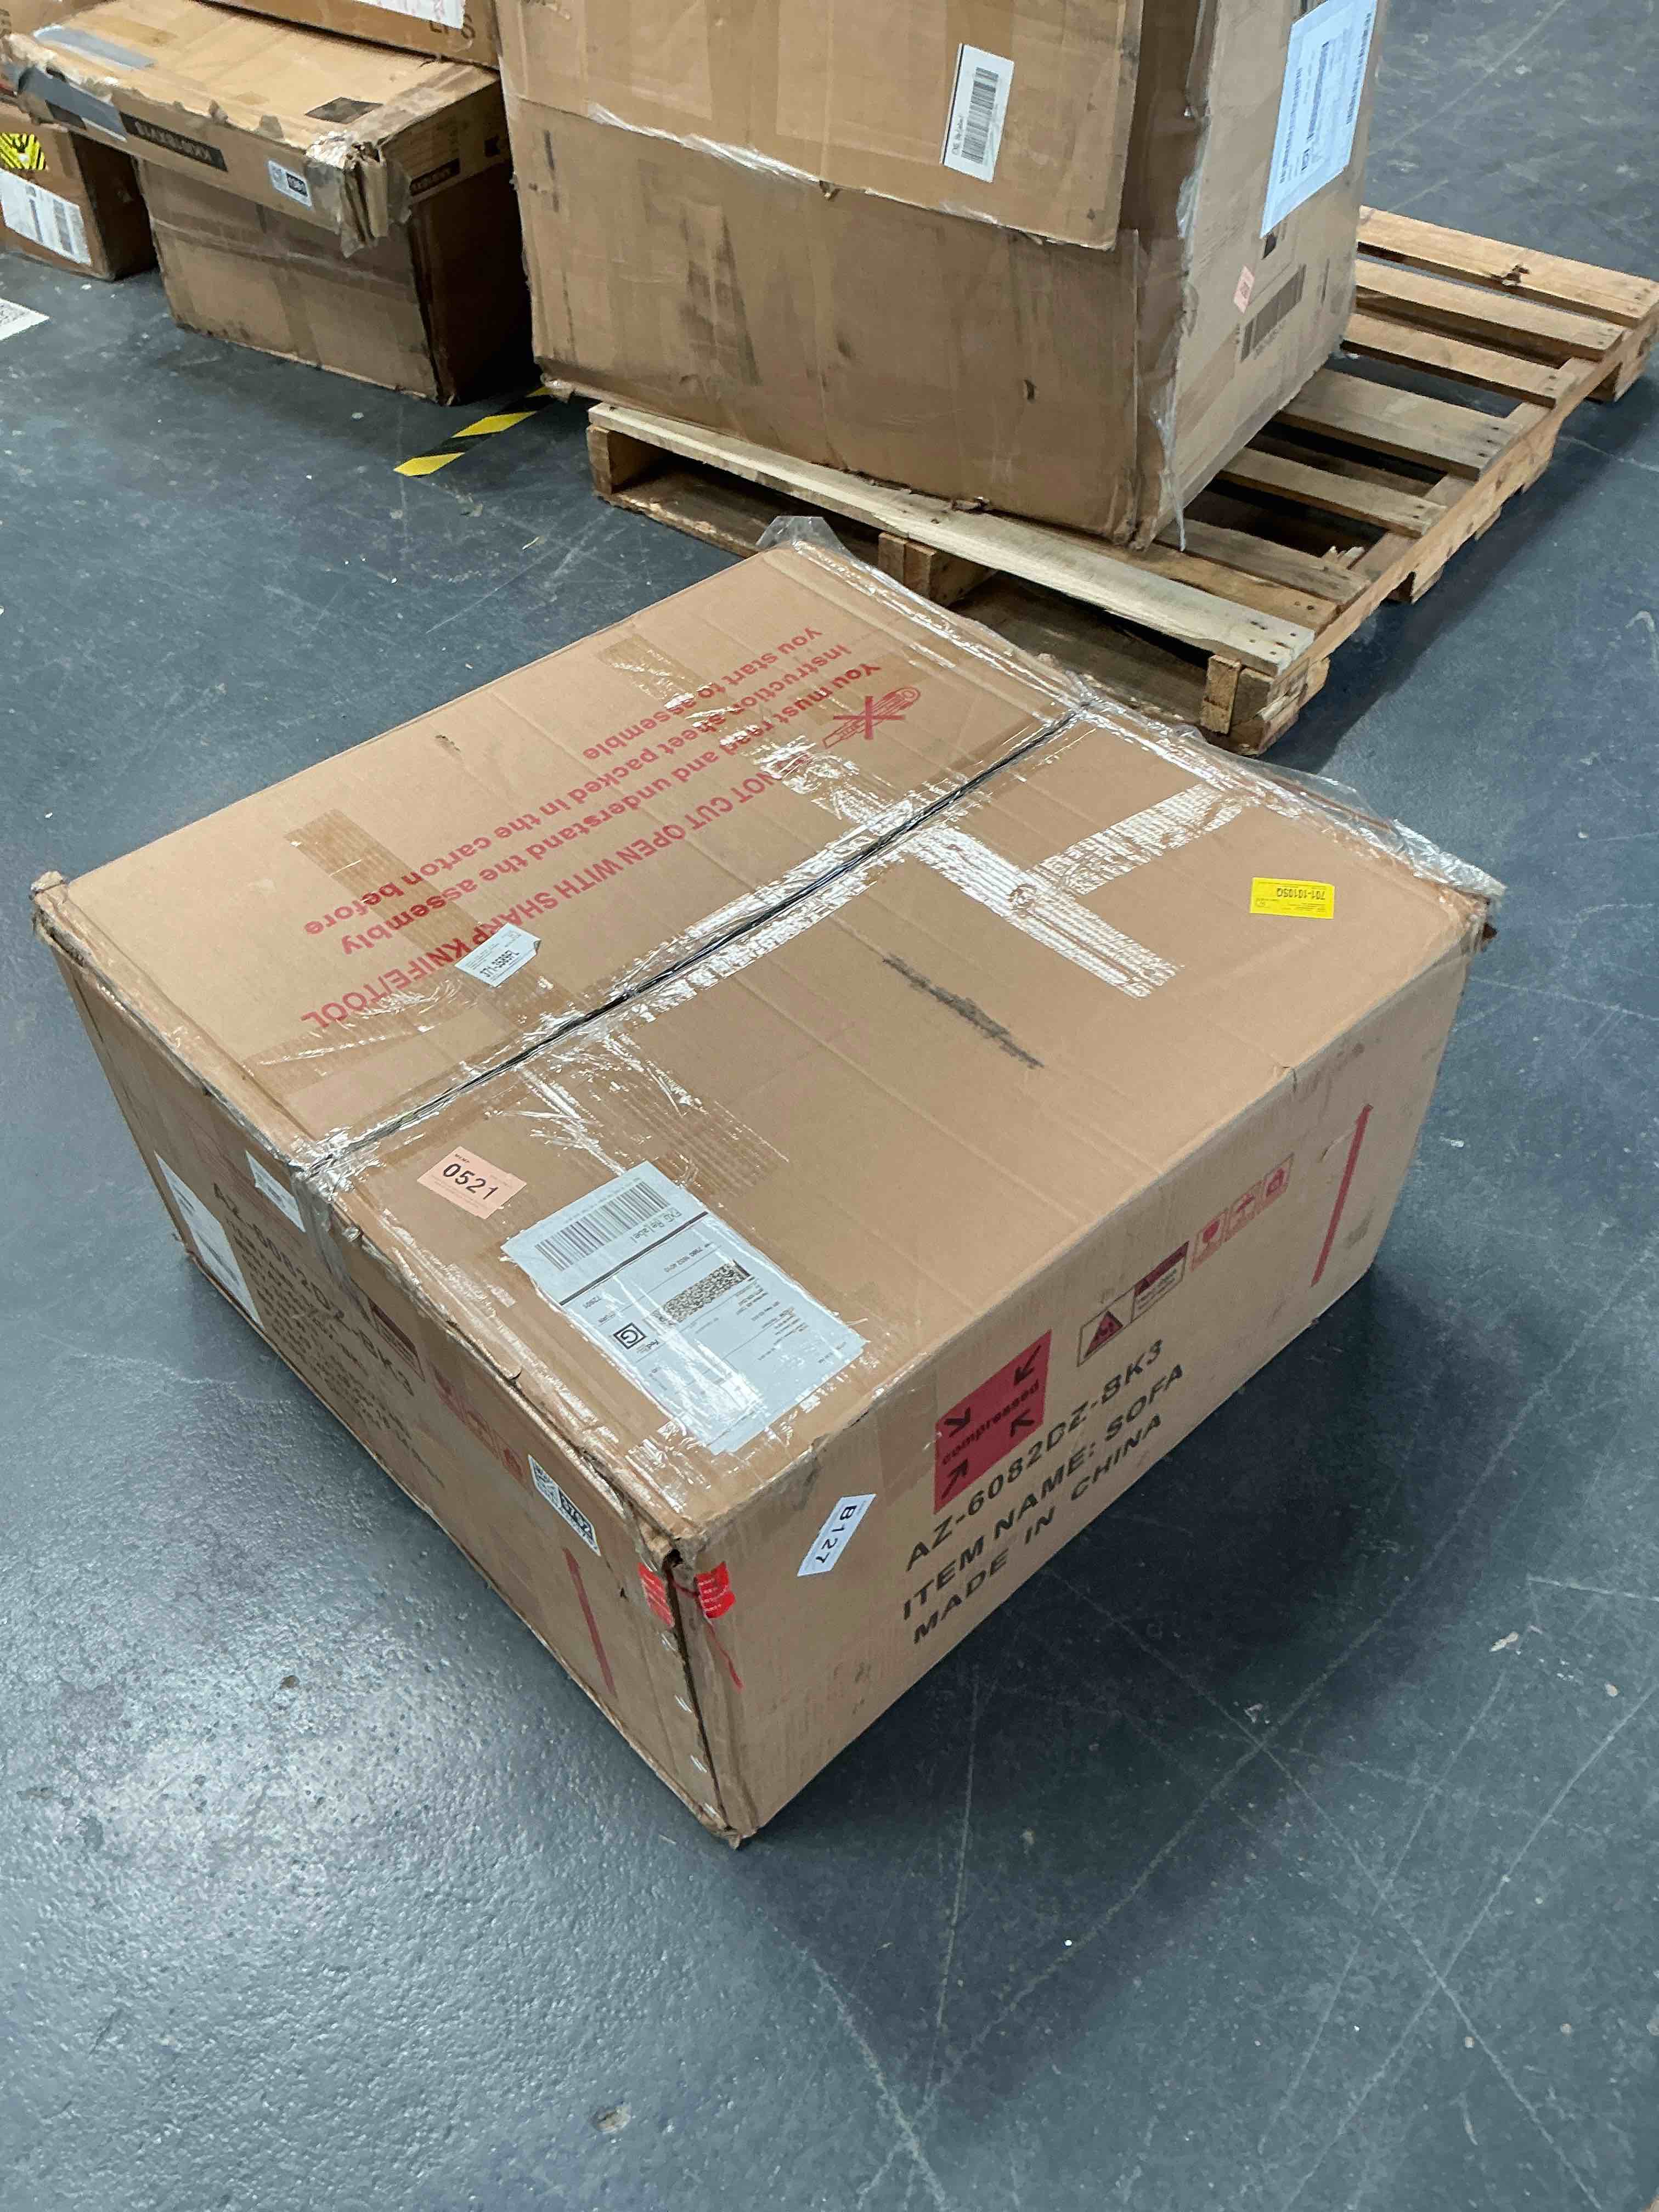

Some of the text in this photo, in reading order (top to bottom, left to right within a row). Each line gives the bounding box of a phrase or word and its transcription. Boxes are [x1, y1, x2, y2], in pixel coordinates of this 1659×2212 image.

[777, 627, 823, 656] you
[697, 681, 726, 698] to
[722, 652, 778, 687] start
[831, 663, 882, 690] You
[772, 687, 831, 726] must
[567, 747, 659, 804] packed
[671, 750, 720, 783] and
[494, 813, 541, 839] the
[526, 777, 673, 861] understand
[539, 798, 572, 817] in
[684, 796, 735, 831] CUT
[400, 837, 492, 885] carton
[615, 823, 687, 866] OPEN
[478, 854, 529, 881] the
[552, 858, 624, 900] WITH
[304, 882, 405, 935] before
[341, 878, 478, 955] assembly
[472, 891, 559, 946] SHARP
[300, 936, 475, 1029] KNIFE/TOOL
[443, 1163, 499, 1200] 0521
[941, 1378, 1040, 1466] compressed
[906, 1338, 1163, 1572] AZ-6082DZ-8K3
[903, 1364, 1184, 1621] ITEM NAME: SOFA
[913, 1414, 1162, 1645] MADE IN CHINA
